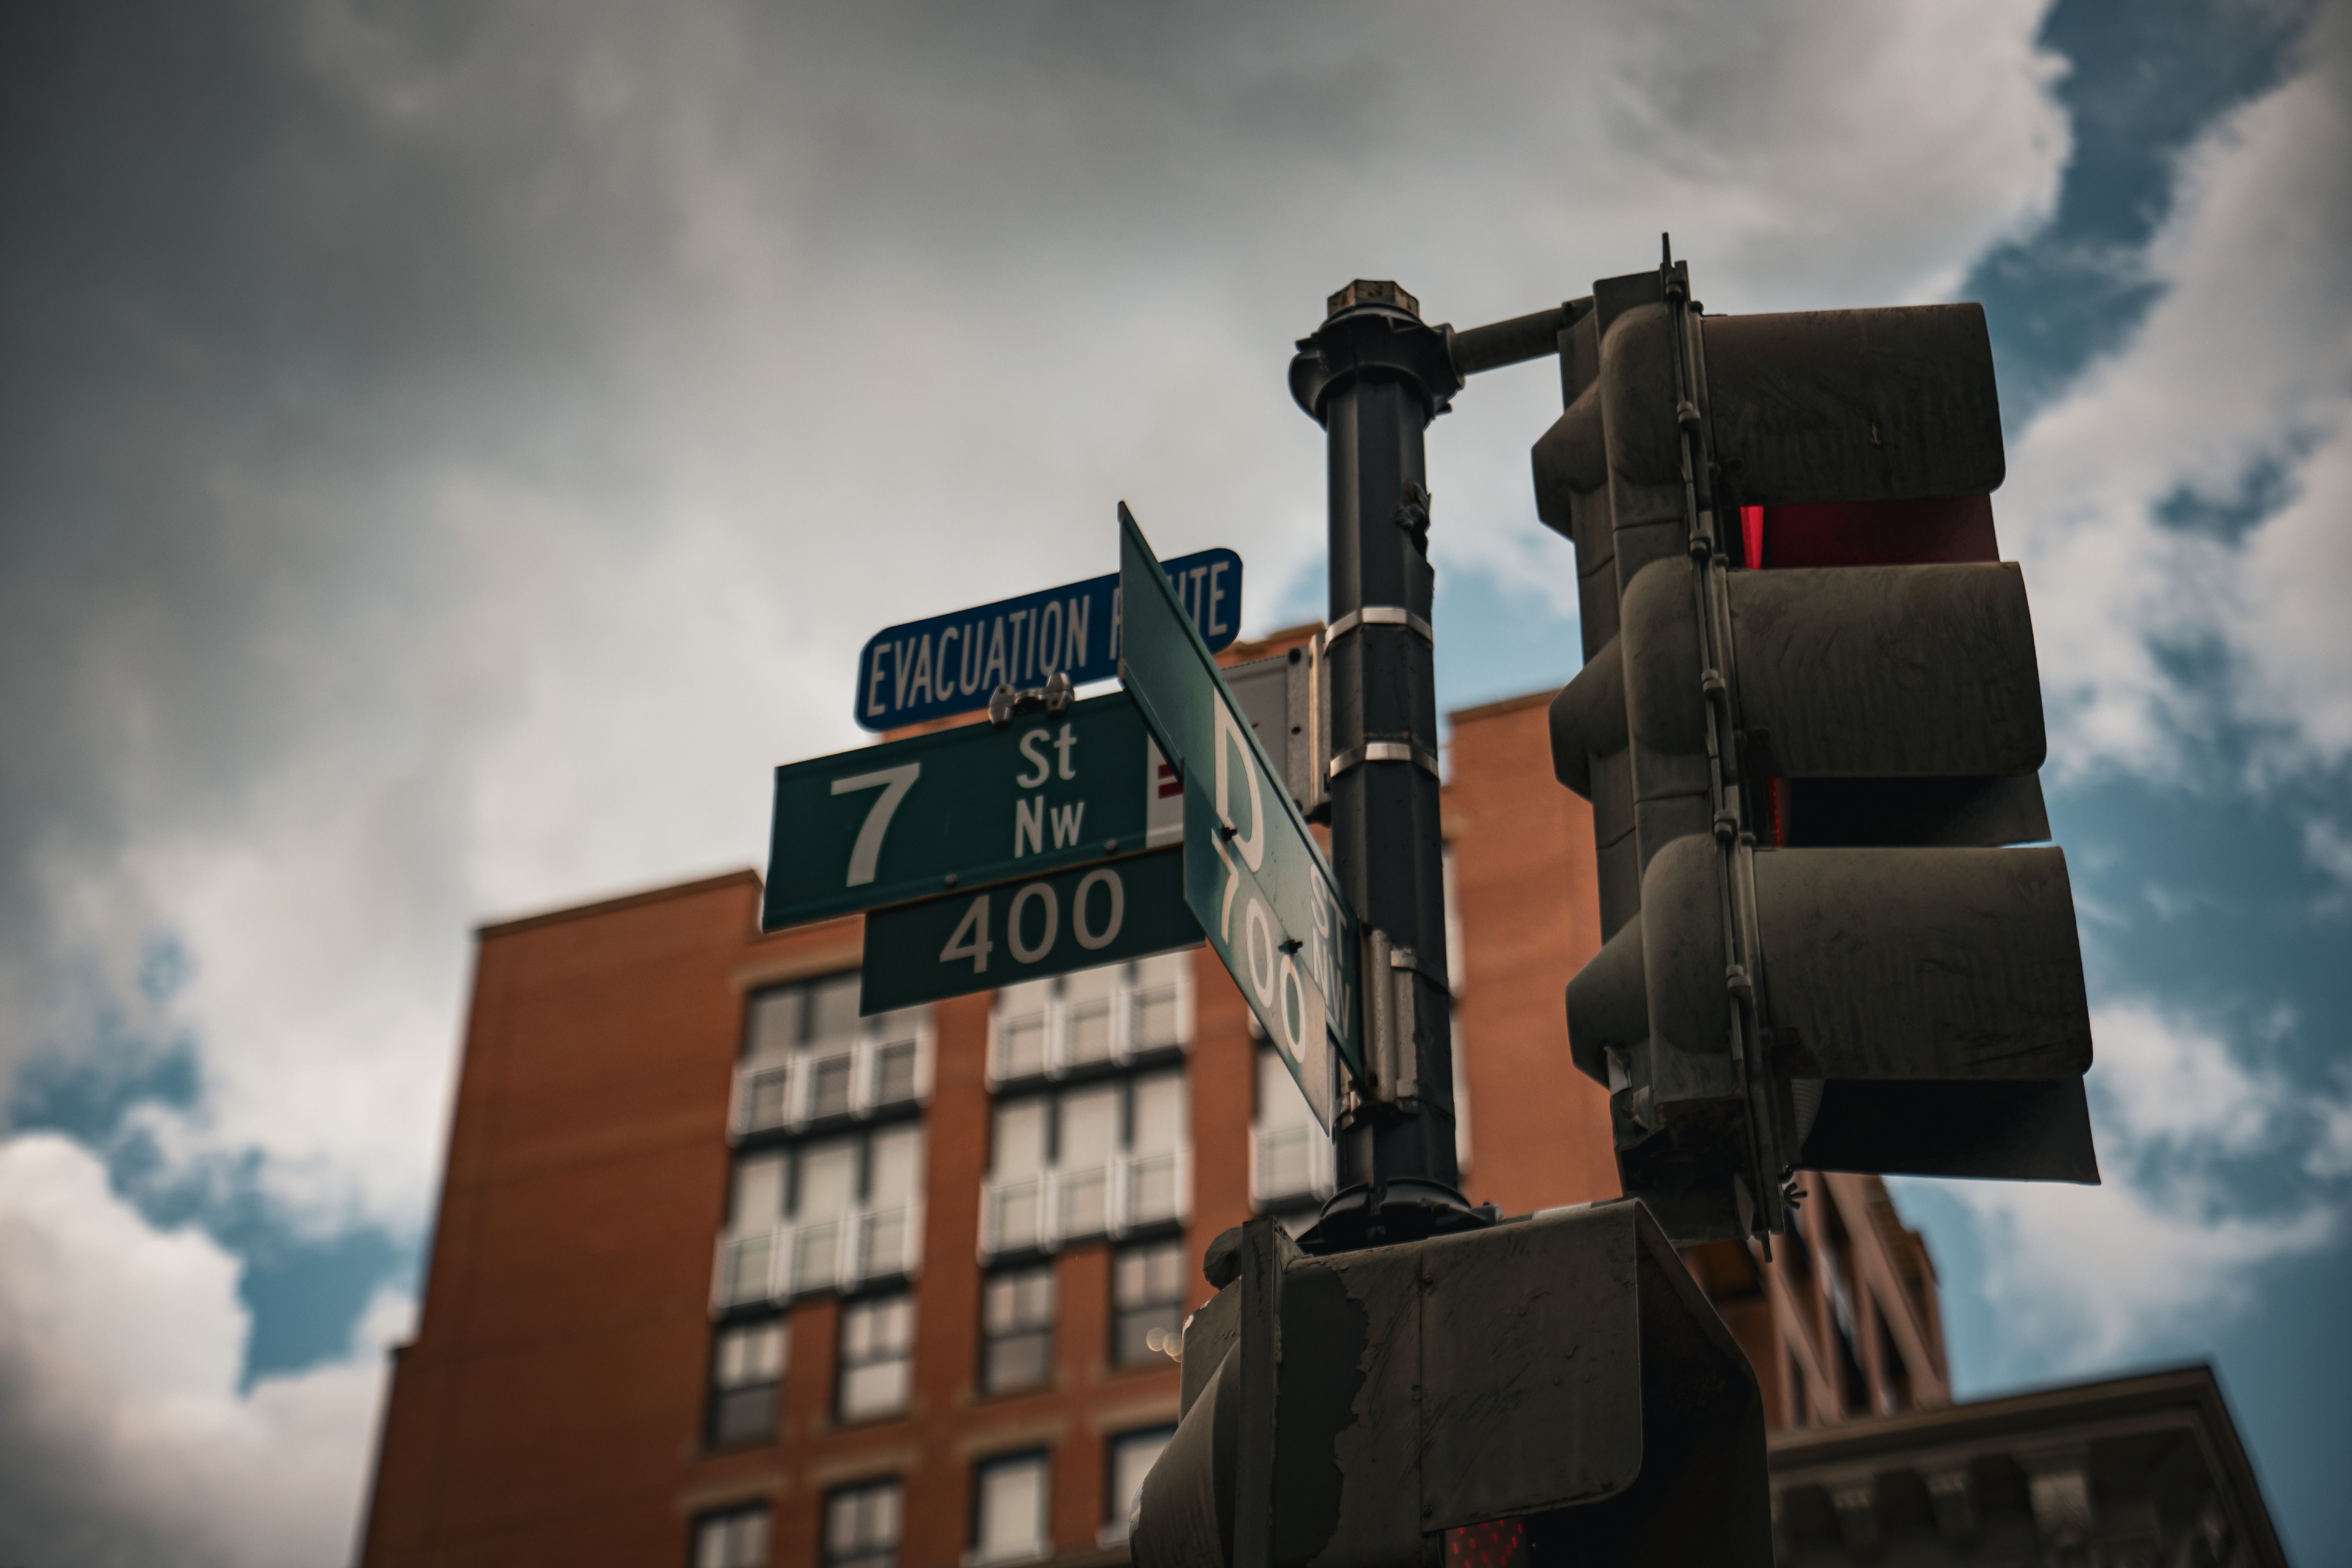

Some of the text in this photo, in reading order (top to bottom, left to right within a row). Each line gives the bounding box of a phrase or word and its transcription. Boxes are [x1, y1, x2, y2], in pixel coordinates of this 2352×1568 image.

[867, 595, 1089, 717] EVACUATION
[831, 723, 1078, 887] 7 St
[1214, 686, 1264, 873] D
[939, 869, 1124, 974] 400
[1211, 828, 1306, 1064] 700
